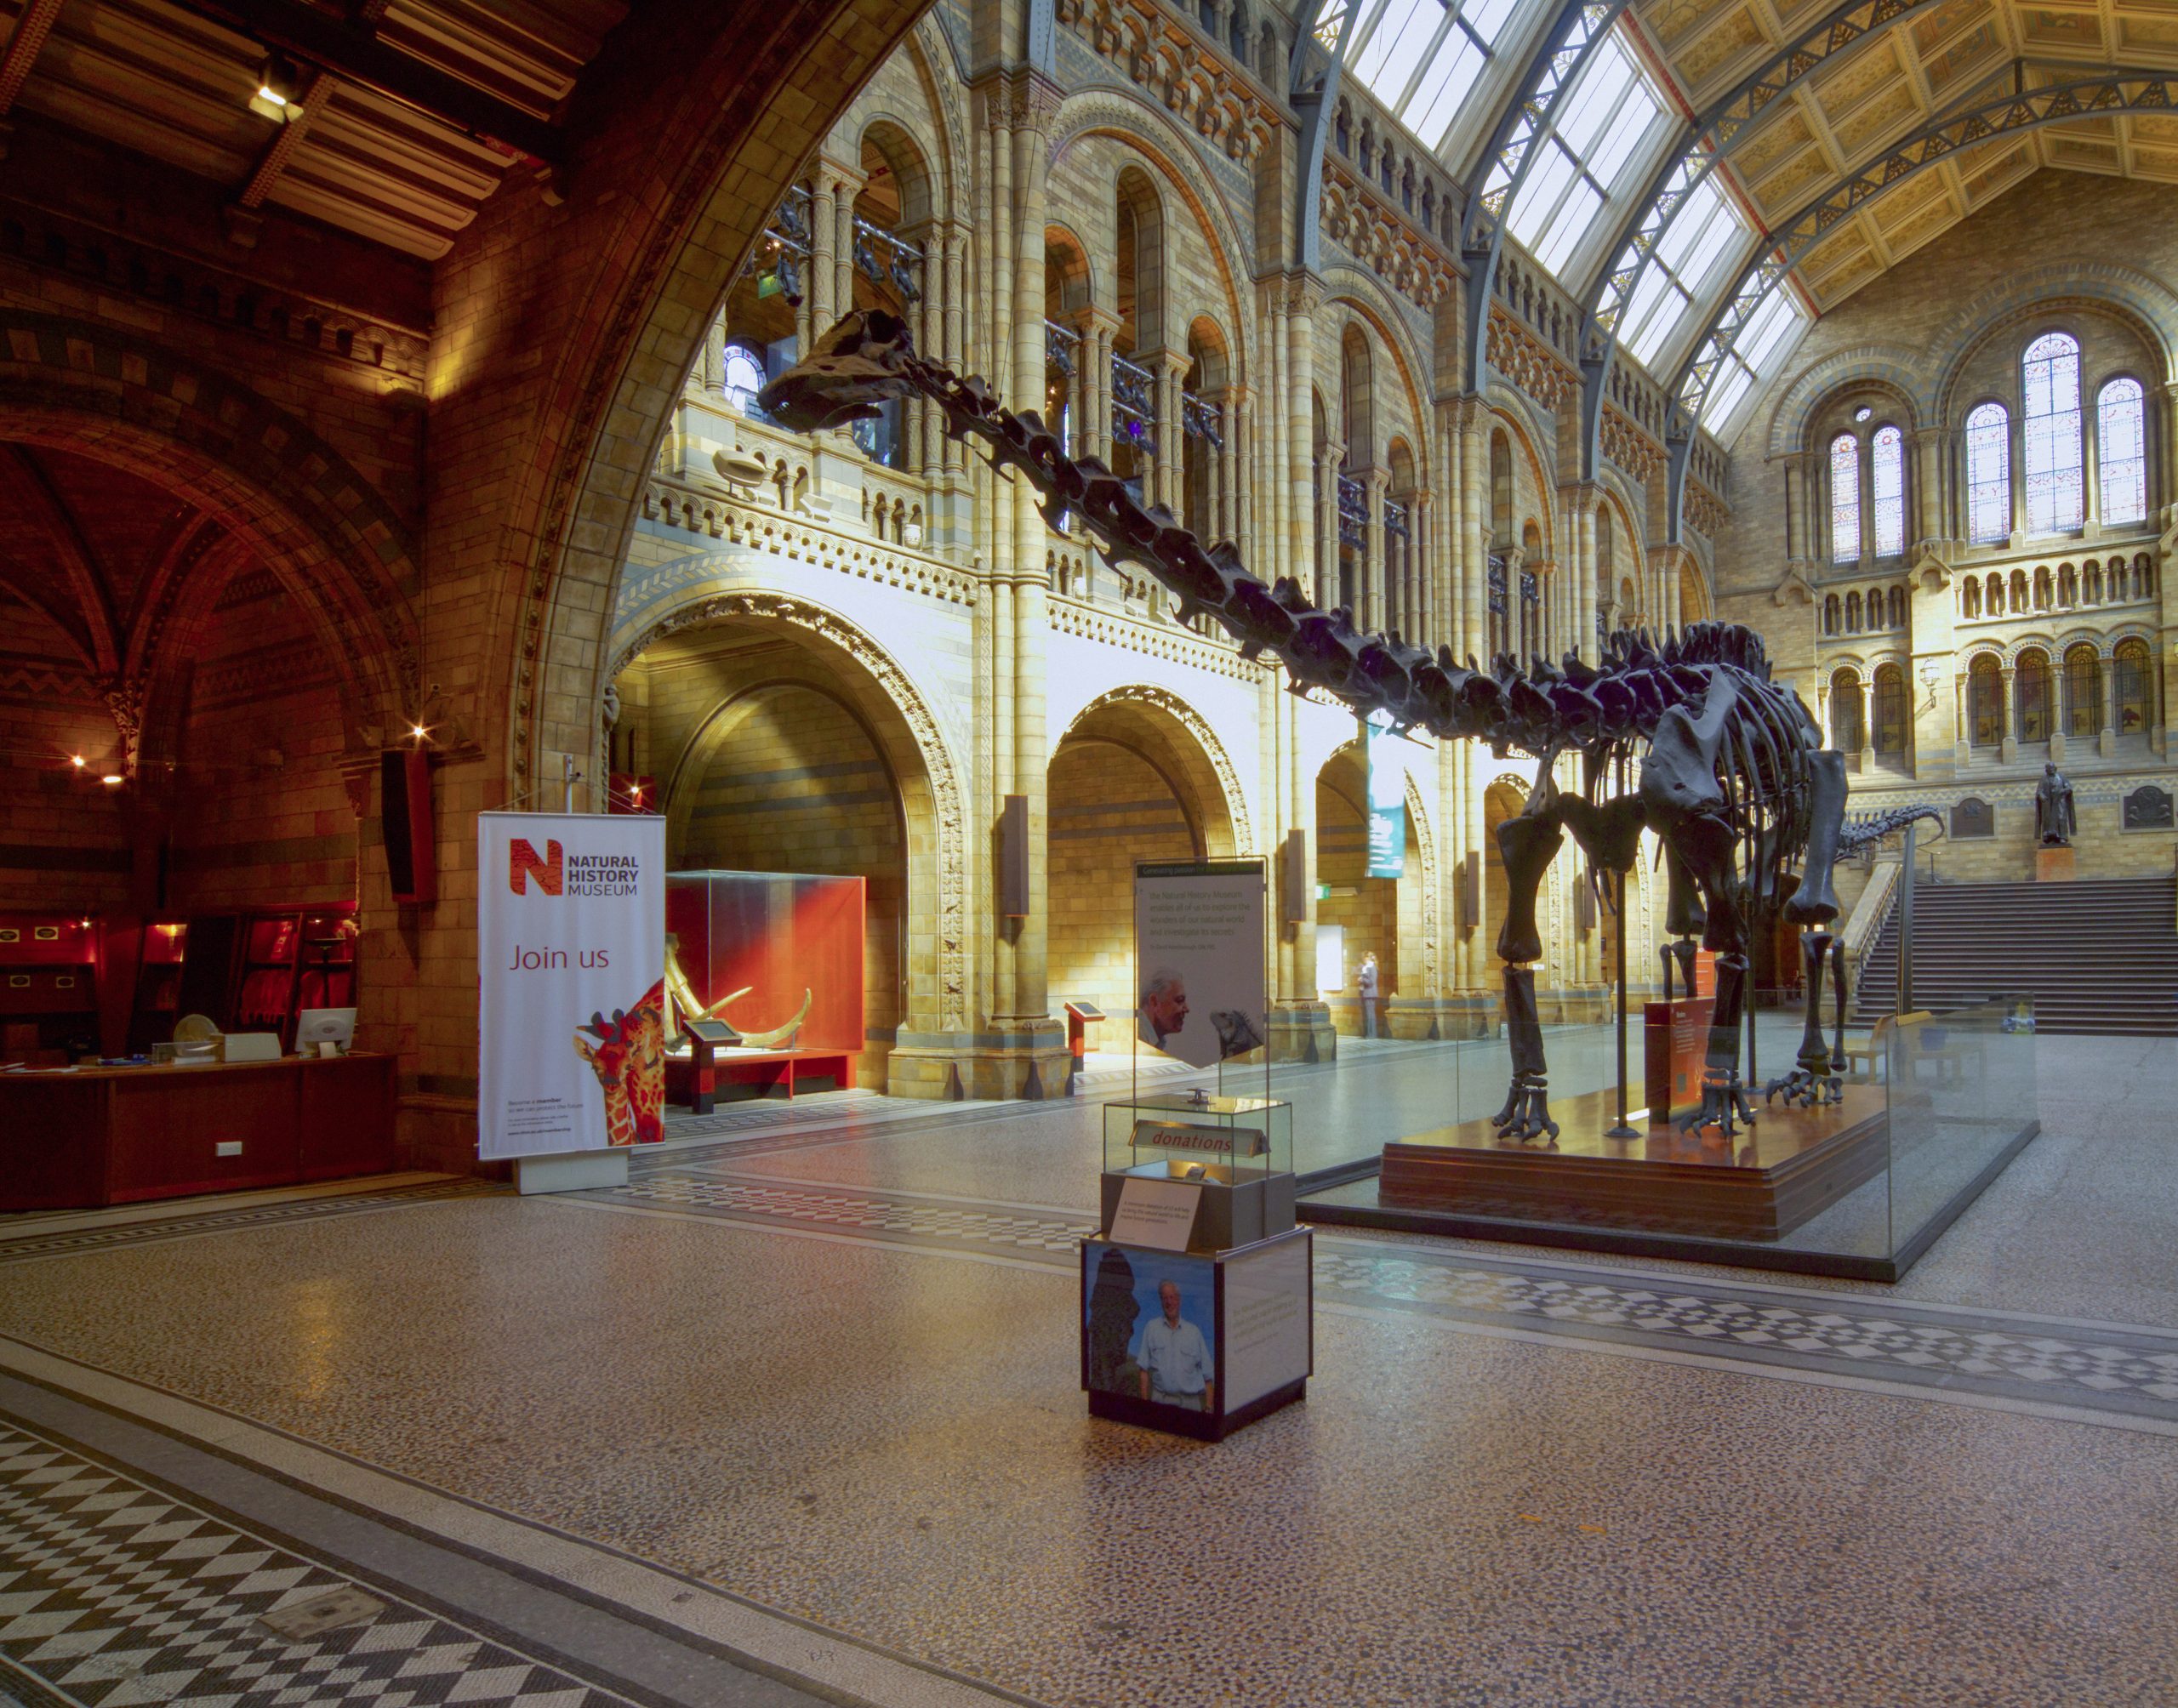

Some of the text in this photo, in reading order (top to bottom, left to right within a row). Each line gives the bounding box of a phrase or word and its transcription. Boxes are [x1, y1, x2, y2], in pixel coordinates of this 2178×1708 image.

[510, 838, 563, 896] N
[568, 856, 639, 868] NATURAL
[568, 870, 639, 882] HISTORY
[567, 884, 637, 896] MUSEUM
[1187, 891, 1212, 900] History
[510, 945, 609, 970] Join us
[1152, 1130, 1232, 1151] donations
